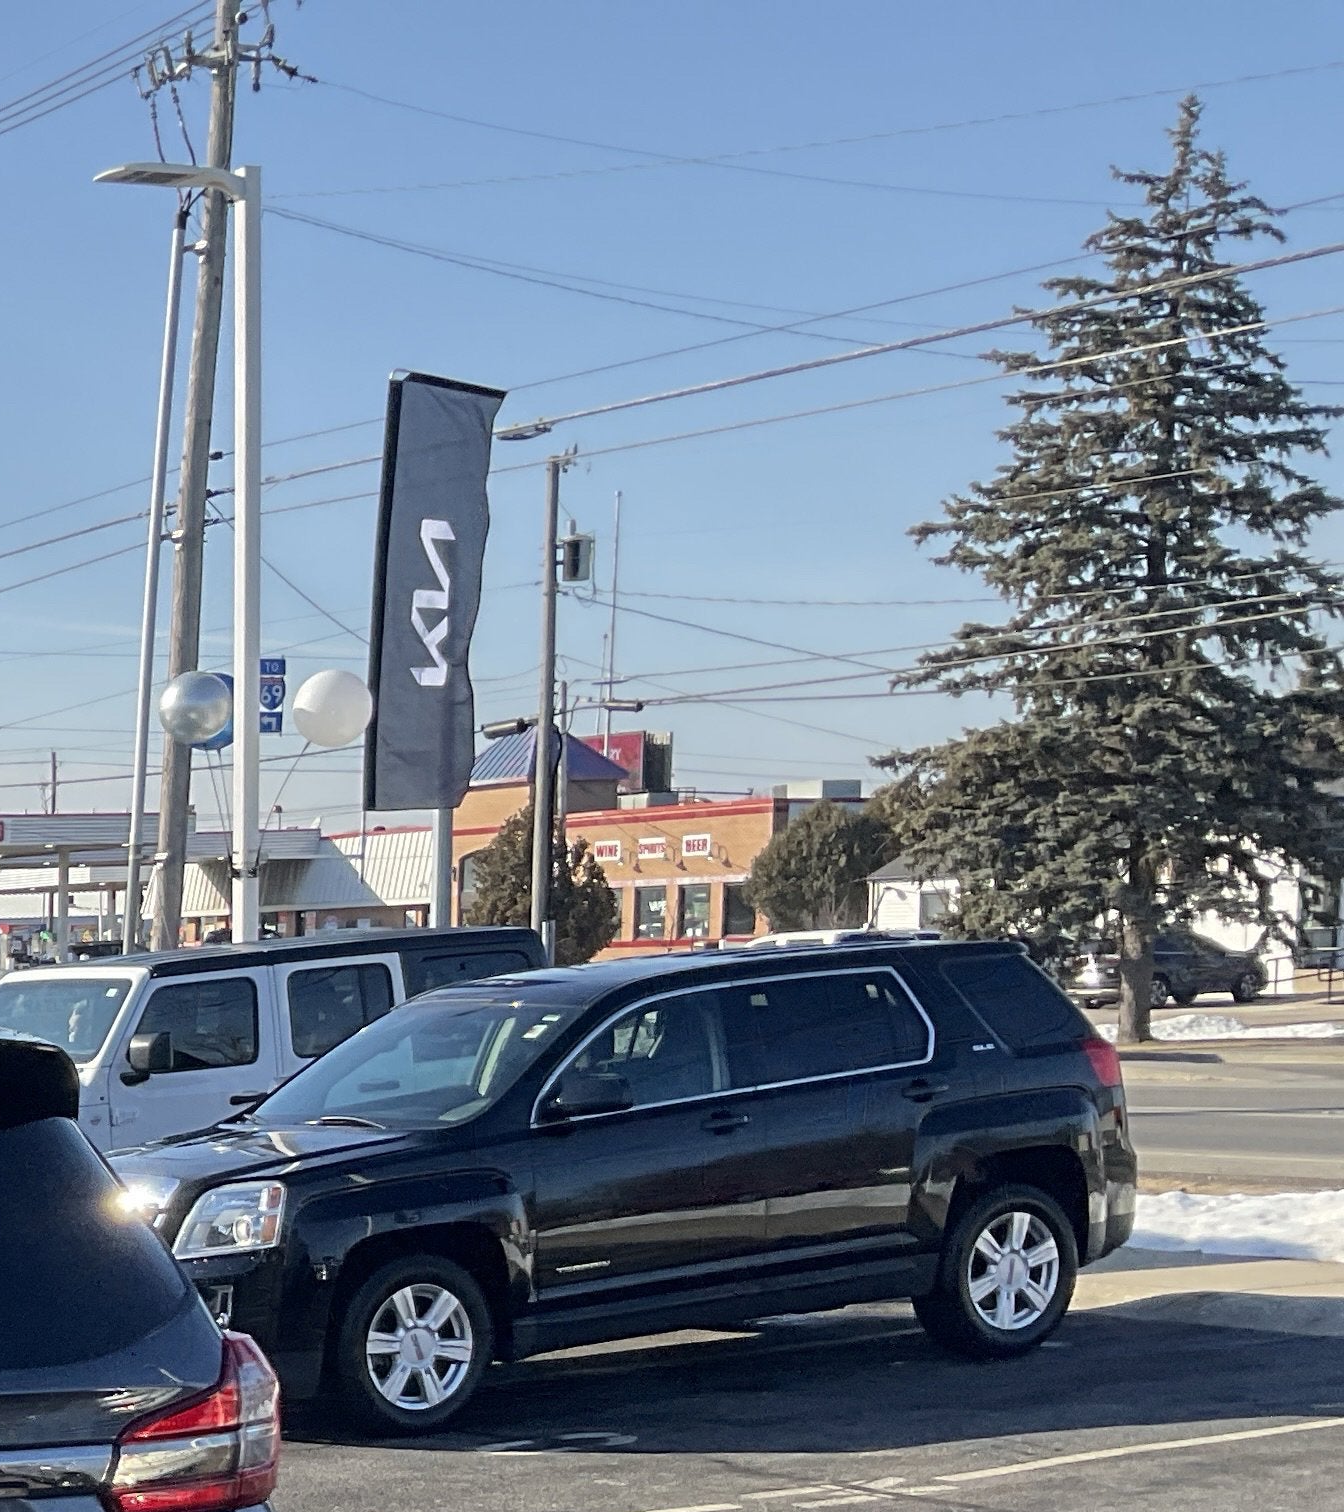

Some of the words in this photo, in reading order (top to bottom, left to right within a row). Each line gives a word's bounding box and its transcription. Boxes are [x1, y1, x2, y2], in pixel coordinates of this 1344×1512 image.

[265, 661, 279, 672] TO
[261, 685, 283, 703] 69
[596, 845, 618, 857] WINE
[685, 839, 708, 852] BEER
